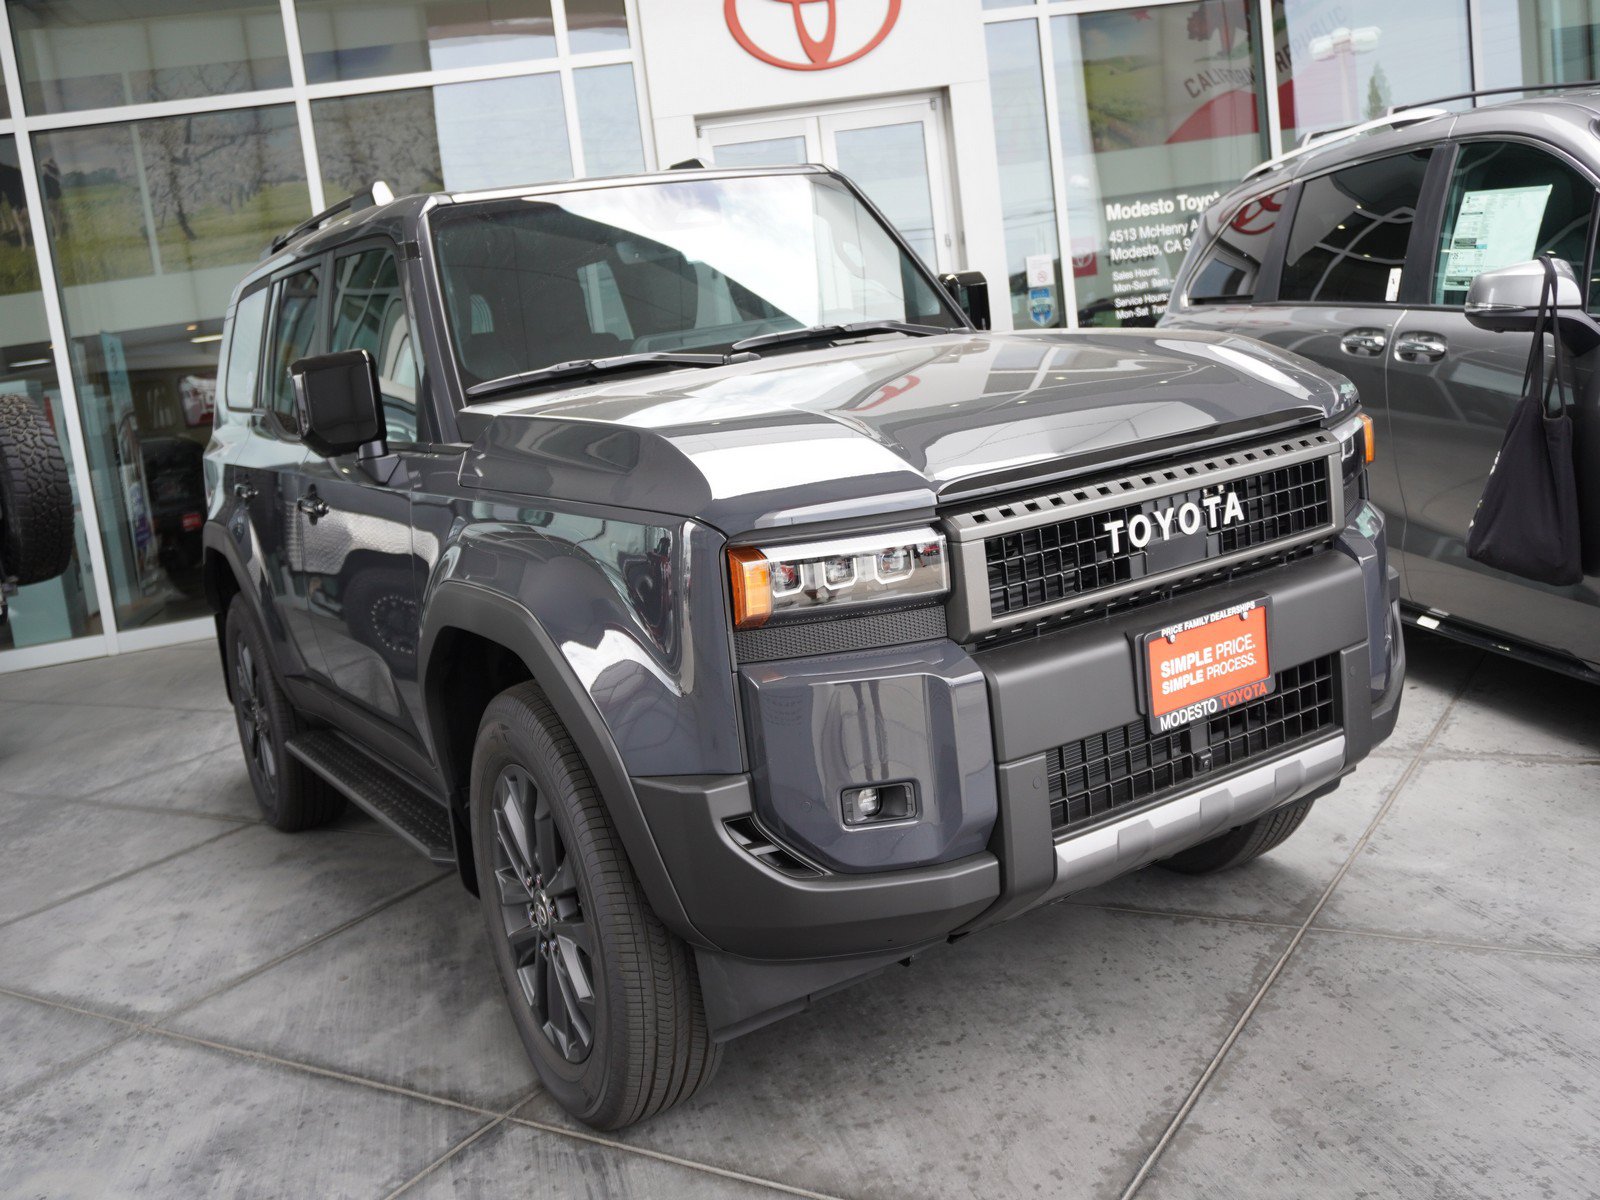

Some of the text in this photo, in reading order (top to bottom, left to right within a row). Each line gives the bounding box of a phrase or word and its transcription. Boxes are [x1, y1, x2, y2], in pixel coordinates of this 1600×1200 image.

[1105, 198, 1175, 221] Modesto
[1109, 227, 1137, 243] 4513
[1138, 222, 1188, 240] McHenry
[1109, 243, 1162, 261] Modesto,
[1163, 239, 1182, 254] CA
[1112, 267, 1160, 281] Sales Hours:
[1113, 280, 1149, 293] Mon-Sun
[1114, 293, 1169, 309] Service Hours:
[1115, 306, 1149, 320] Mon-Sat
[1104, 491, 1245, 554] TOYOTA
[1161, 601, 1256, 638] PRICE FAMILY DEALERSHIPS
[1160, 633, 1257, 678] SIMPLE PRICE.
[1161, 652, 1257, 695] SIMPLE PROCESS.
[1160, 681, 1268, 732] MODESTO TOYOTA
